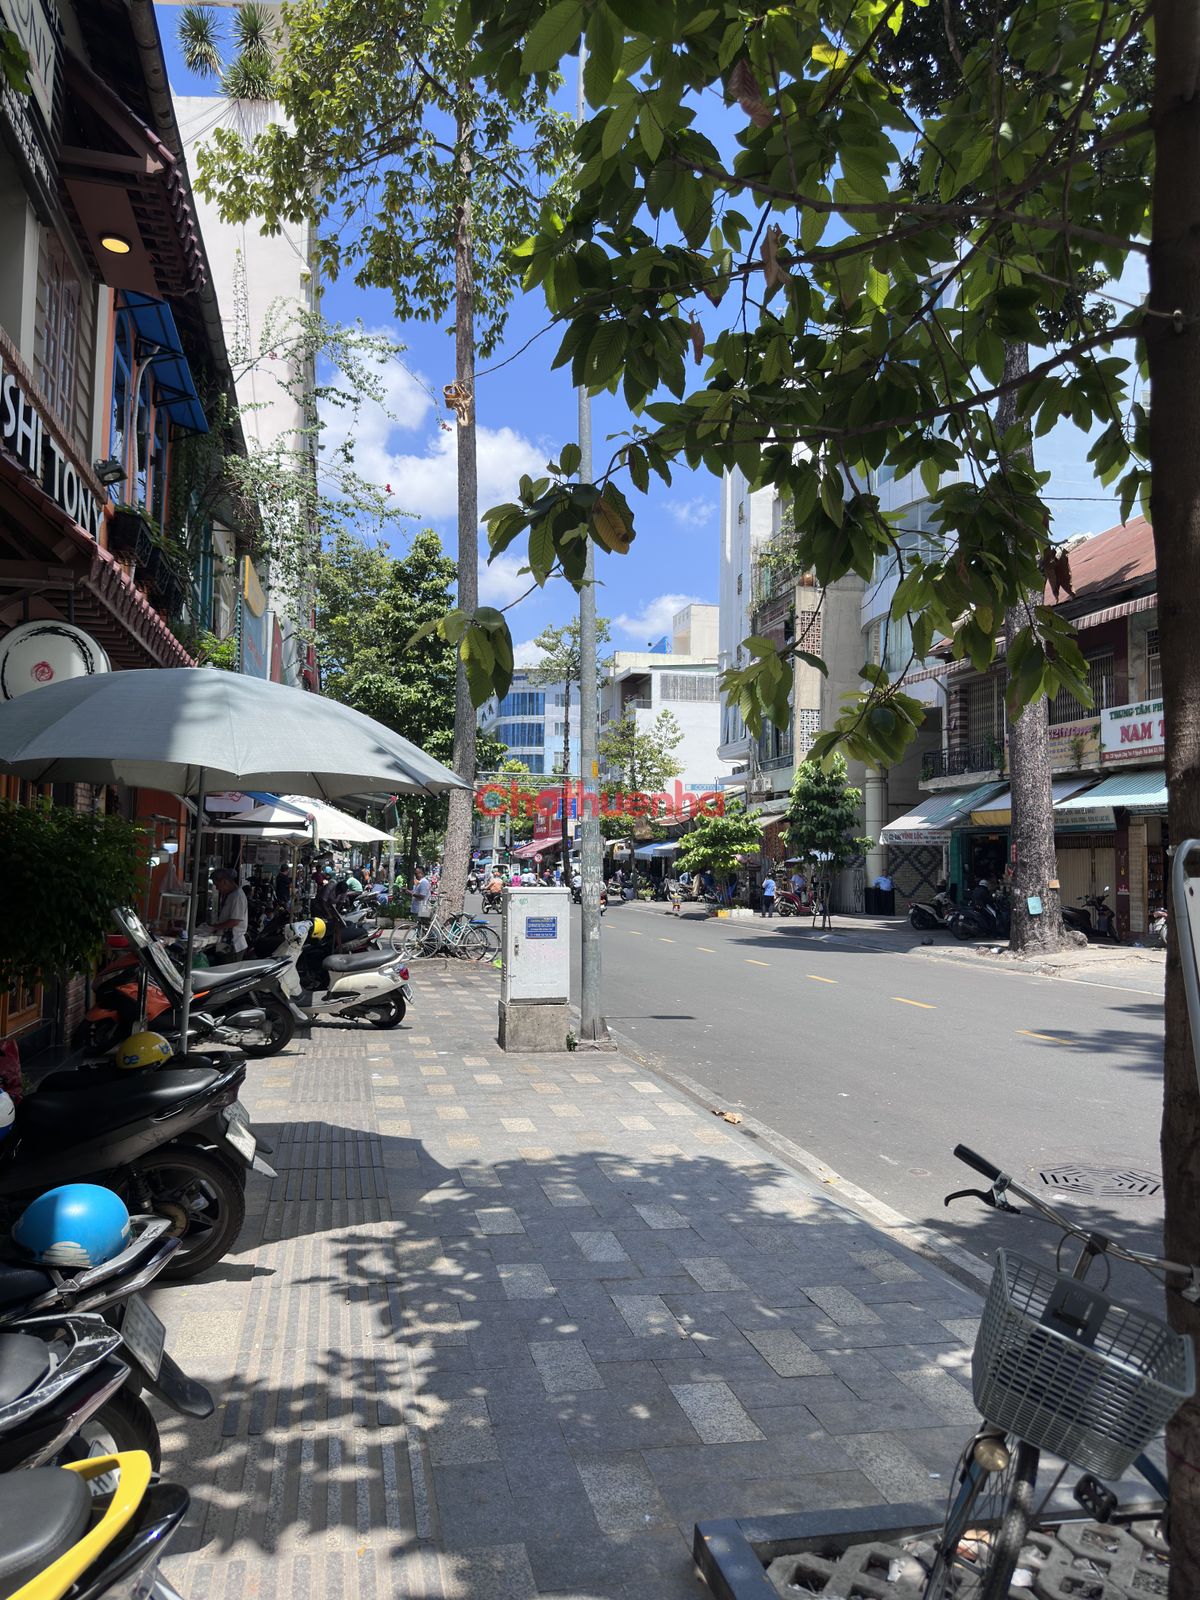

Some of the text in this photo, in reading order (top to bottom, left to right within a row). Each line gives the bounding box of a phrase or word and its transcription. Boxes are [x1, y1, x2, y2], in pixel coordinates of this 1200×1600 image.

[0, 354, 104, 543] SHI TONY
[1120, 721, 1153, 744] NAM
